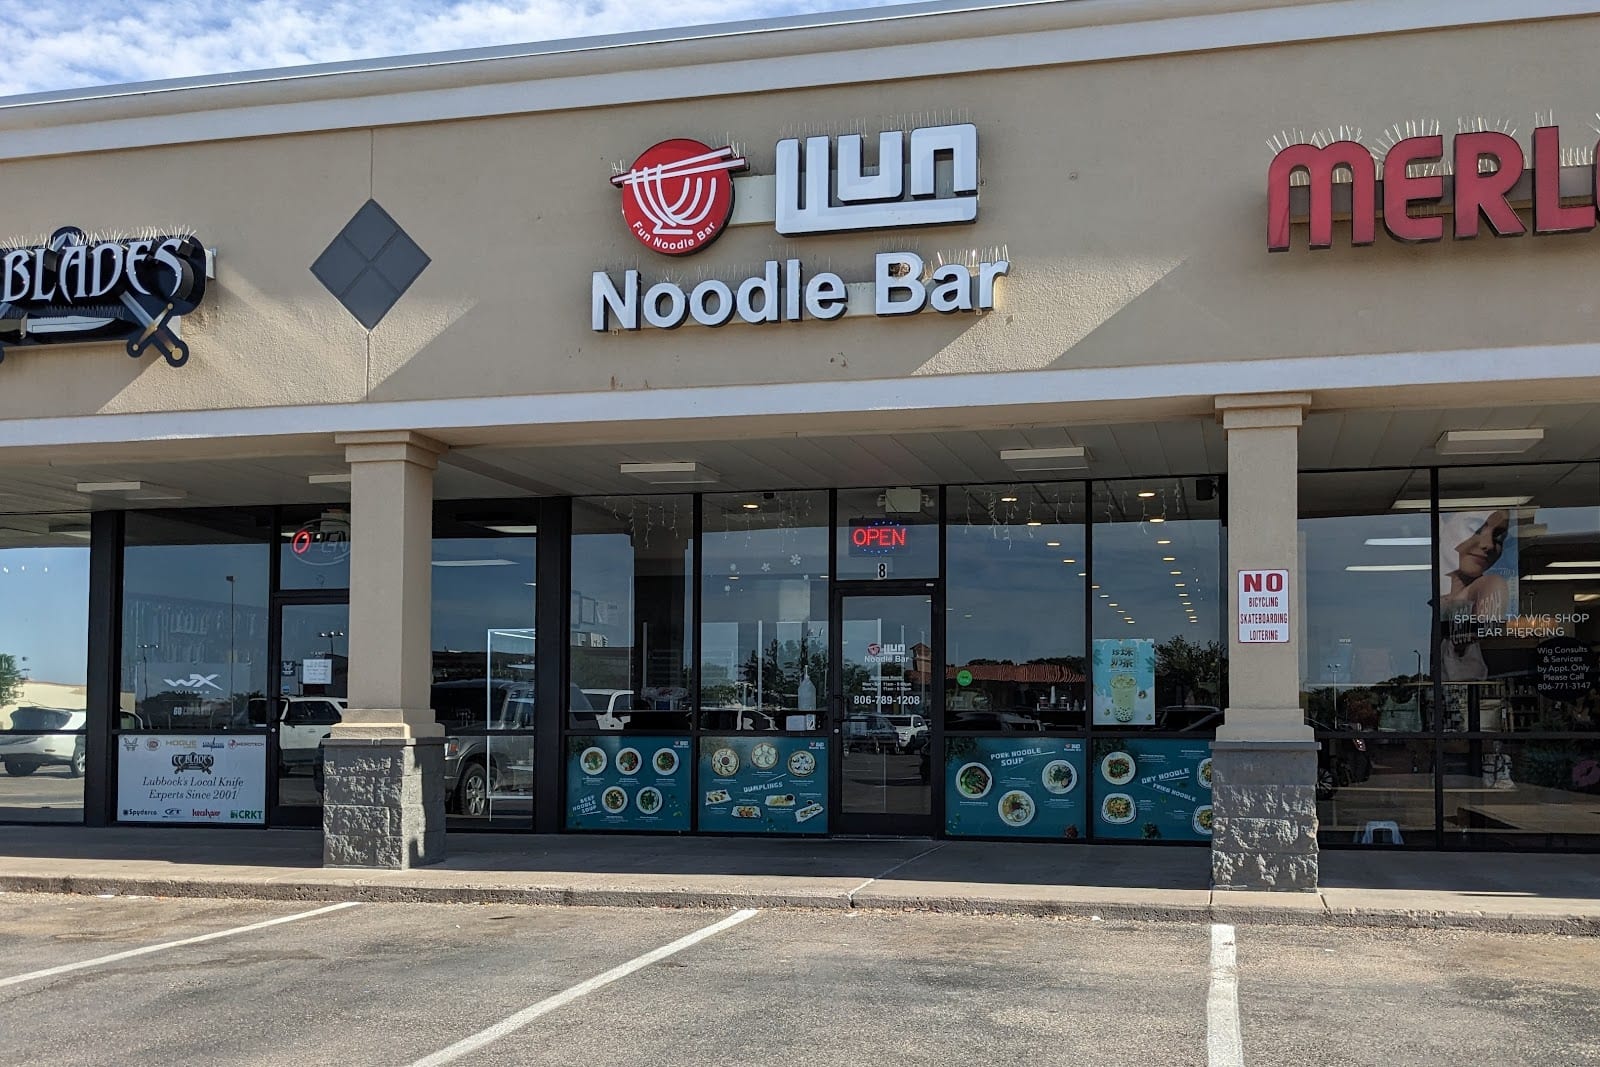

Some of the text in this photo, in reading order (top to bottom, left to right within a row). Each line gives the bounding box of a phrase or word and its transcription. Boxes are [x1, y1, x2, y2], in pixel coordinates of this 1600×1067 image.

[1266, 125, 1600, 252] MERL
[632, 220, 717, 251] Fun Noodle Bar
[2, 238, 186, 304] BLADES
[592, 251, 1010, 332] Noodle Bar
[852, 527, 907, 546] OPEN
[878, 562, 887, 578] 8
[1243, 572, 1283, 592] NO
[1248, 596, 1279, 608] BICYCLING
[1240, 613, 1288, 624] SKATEBOARDING
[1454, 613, 1590, 624] SPECIALTY WIG SHOP
[1249, 629, 1279, 641] LOITERING
[1477, 626, 1565, 638] EAR PIERCING
[1537, 646, 1588, 656] Wig Consults
[864, 655, 910, 663] Noodle Bar
[1537, 664, 1590, 673] by Appt. Only
[1569, 672, 1585, 680] Call
[1537, 682, 1591, 691] 806-771-3147
[853, 695, 920, 705] 806-789-1208
[1011, 747, 1041, 757] NOODLE
[1000, 757, 1024, 766] SOUP
[1158, 768, 1190, 780] NOODLE
[142, 776, 244, 790] Lubbock's Local Knife
[149, 790, 238, 802] Experts Since 2001
[238, 809, 263, 820] CRKT
